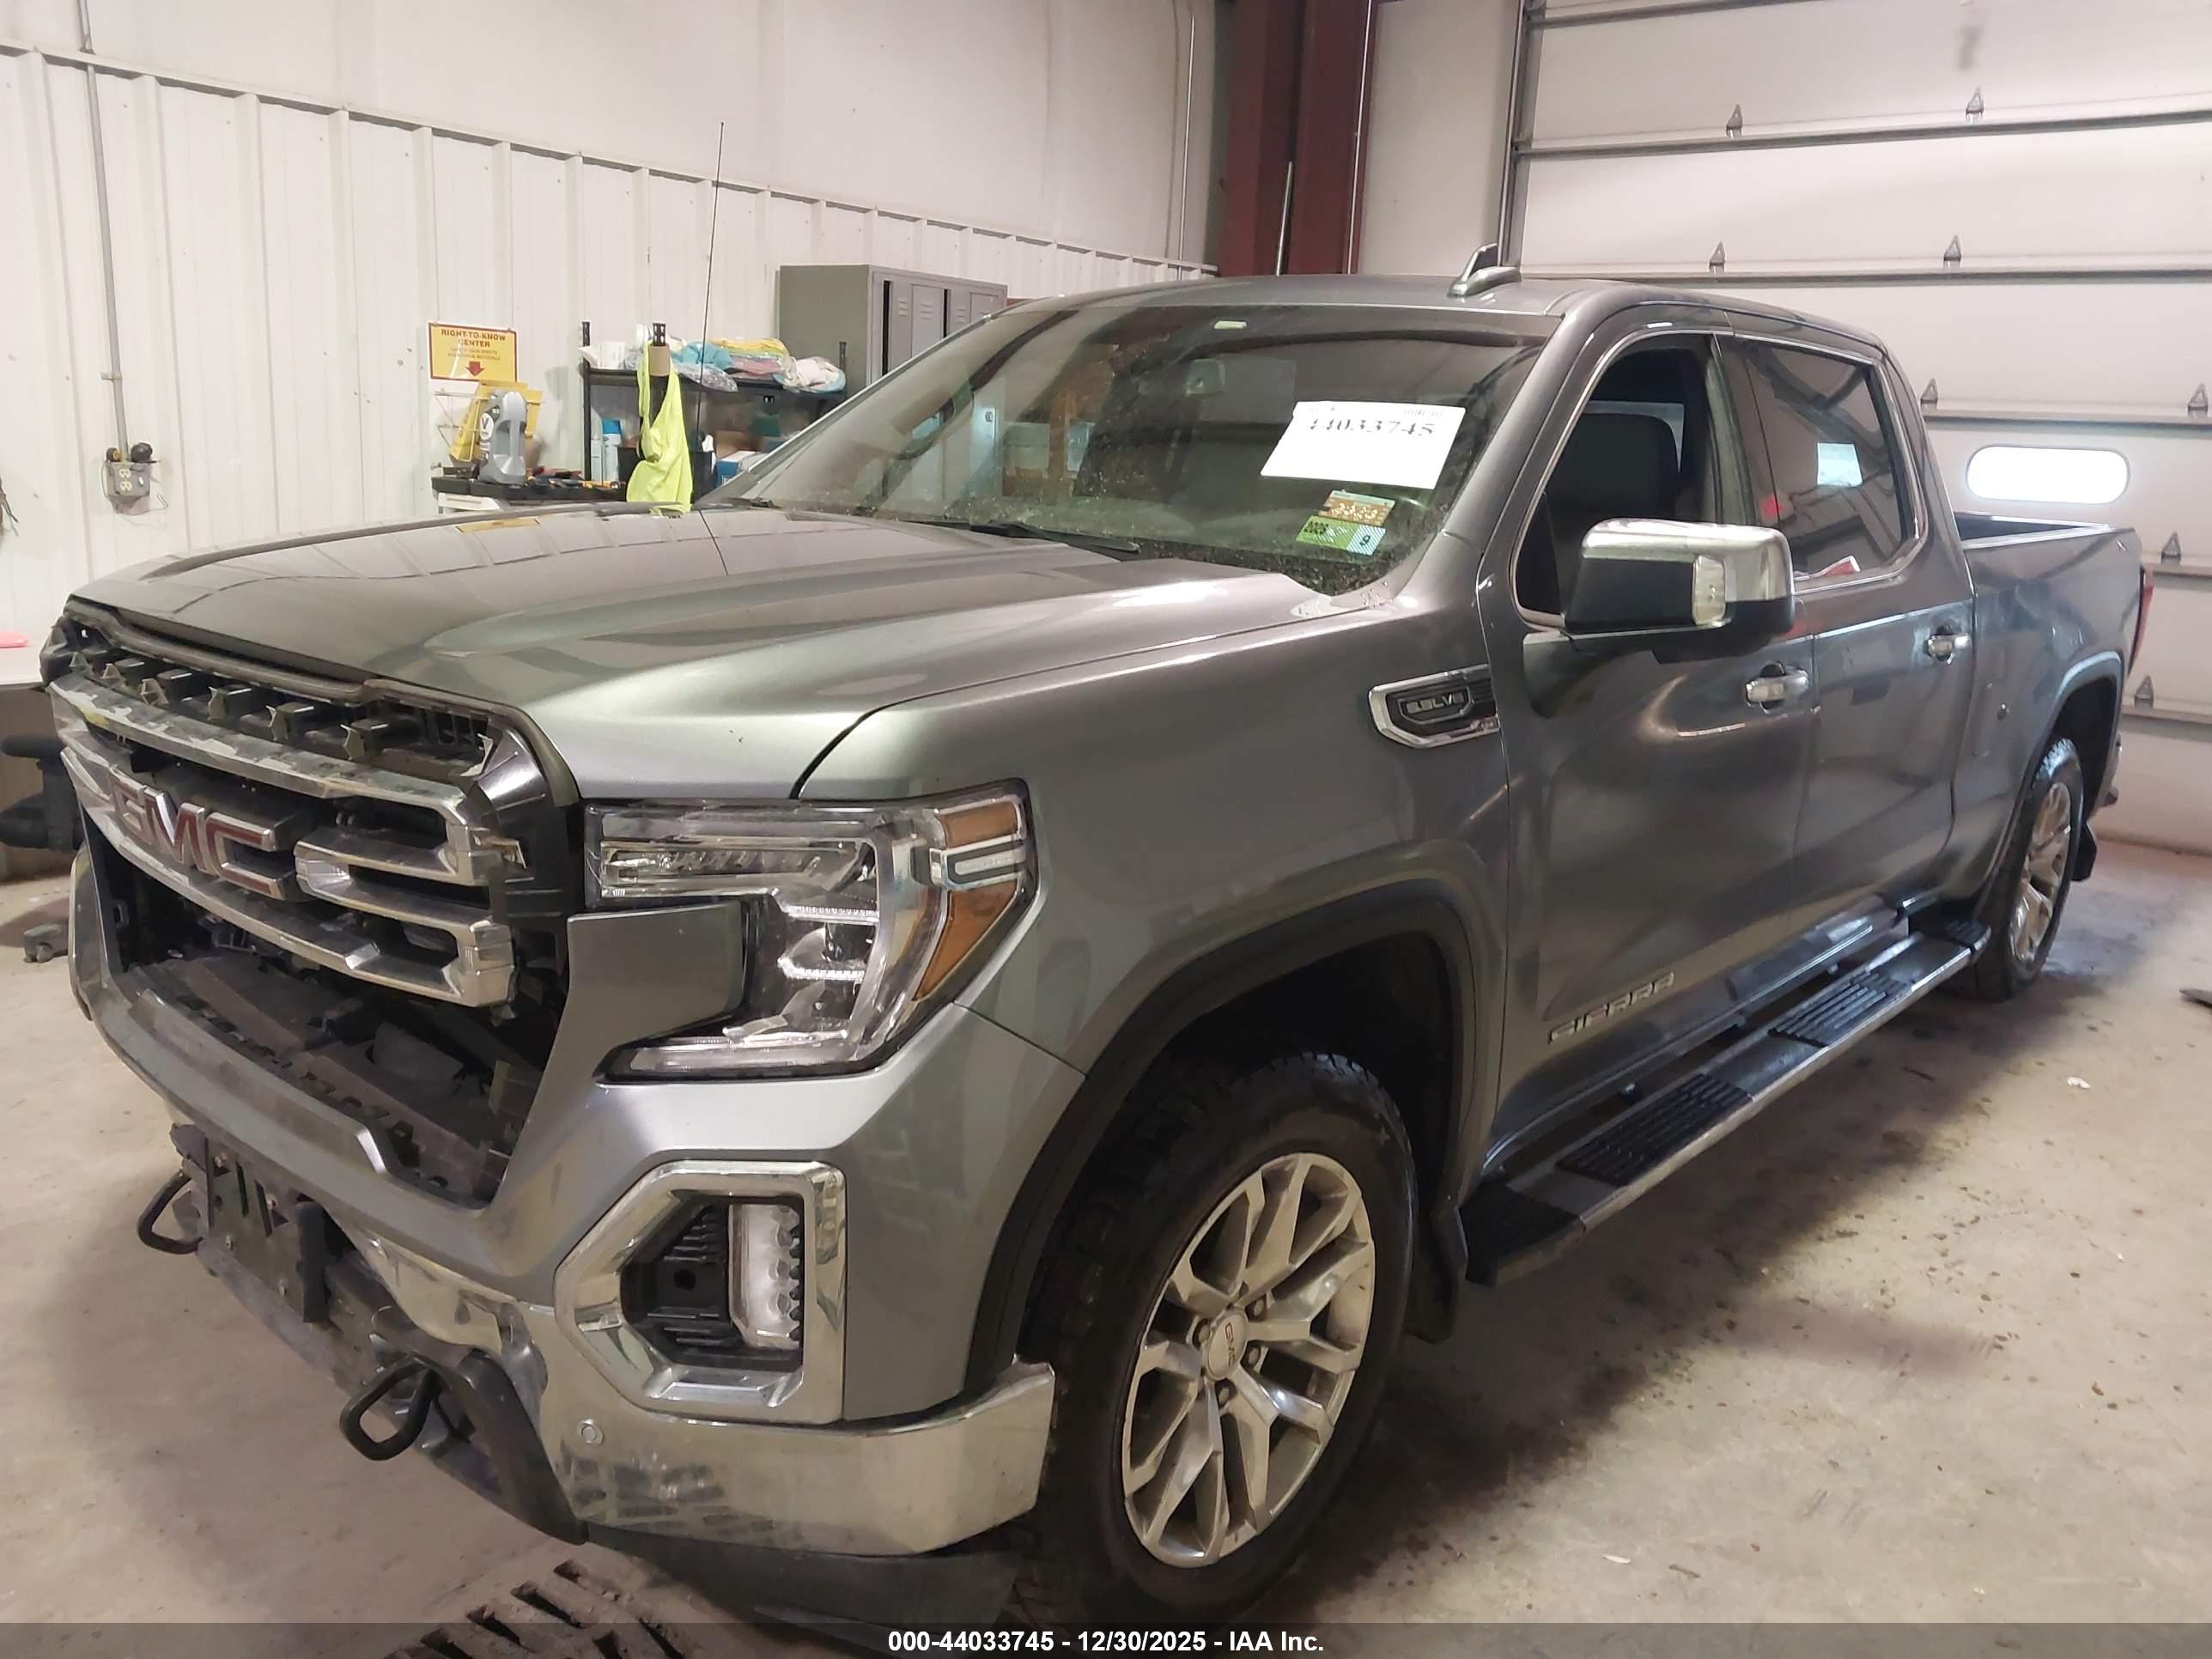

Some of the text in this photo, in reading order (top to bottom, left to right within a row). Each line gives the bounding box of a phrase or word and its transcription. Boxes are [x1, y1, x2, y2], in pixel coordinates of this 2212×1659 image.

[441, 329, 506, 341] RIGHT-TO-KNOW
[459, 339, 490, 348] CENTER
[109, 766, 286, 901] GMC
